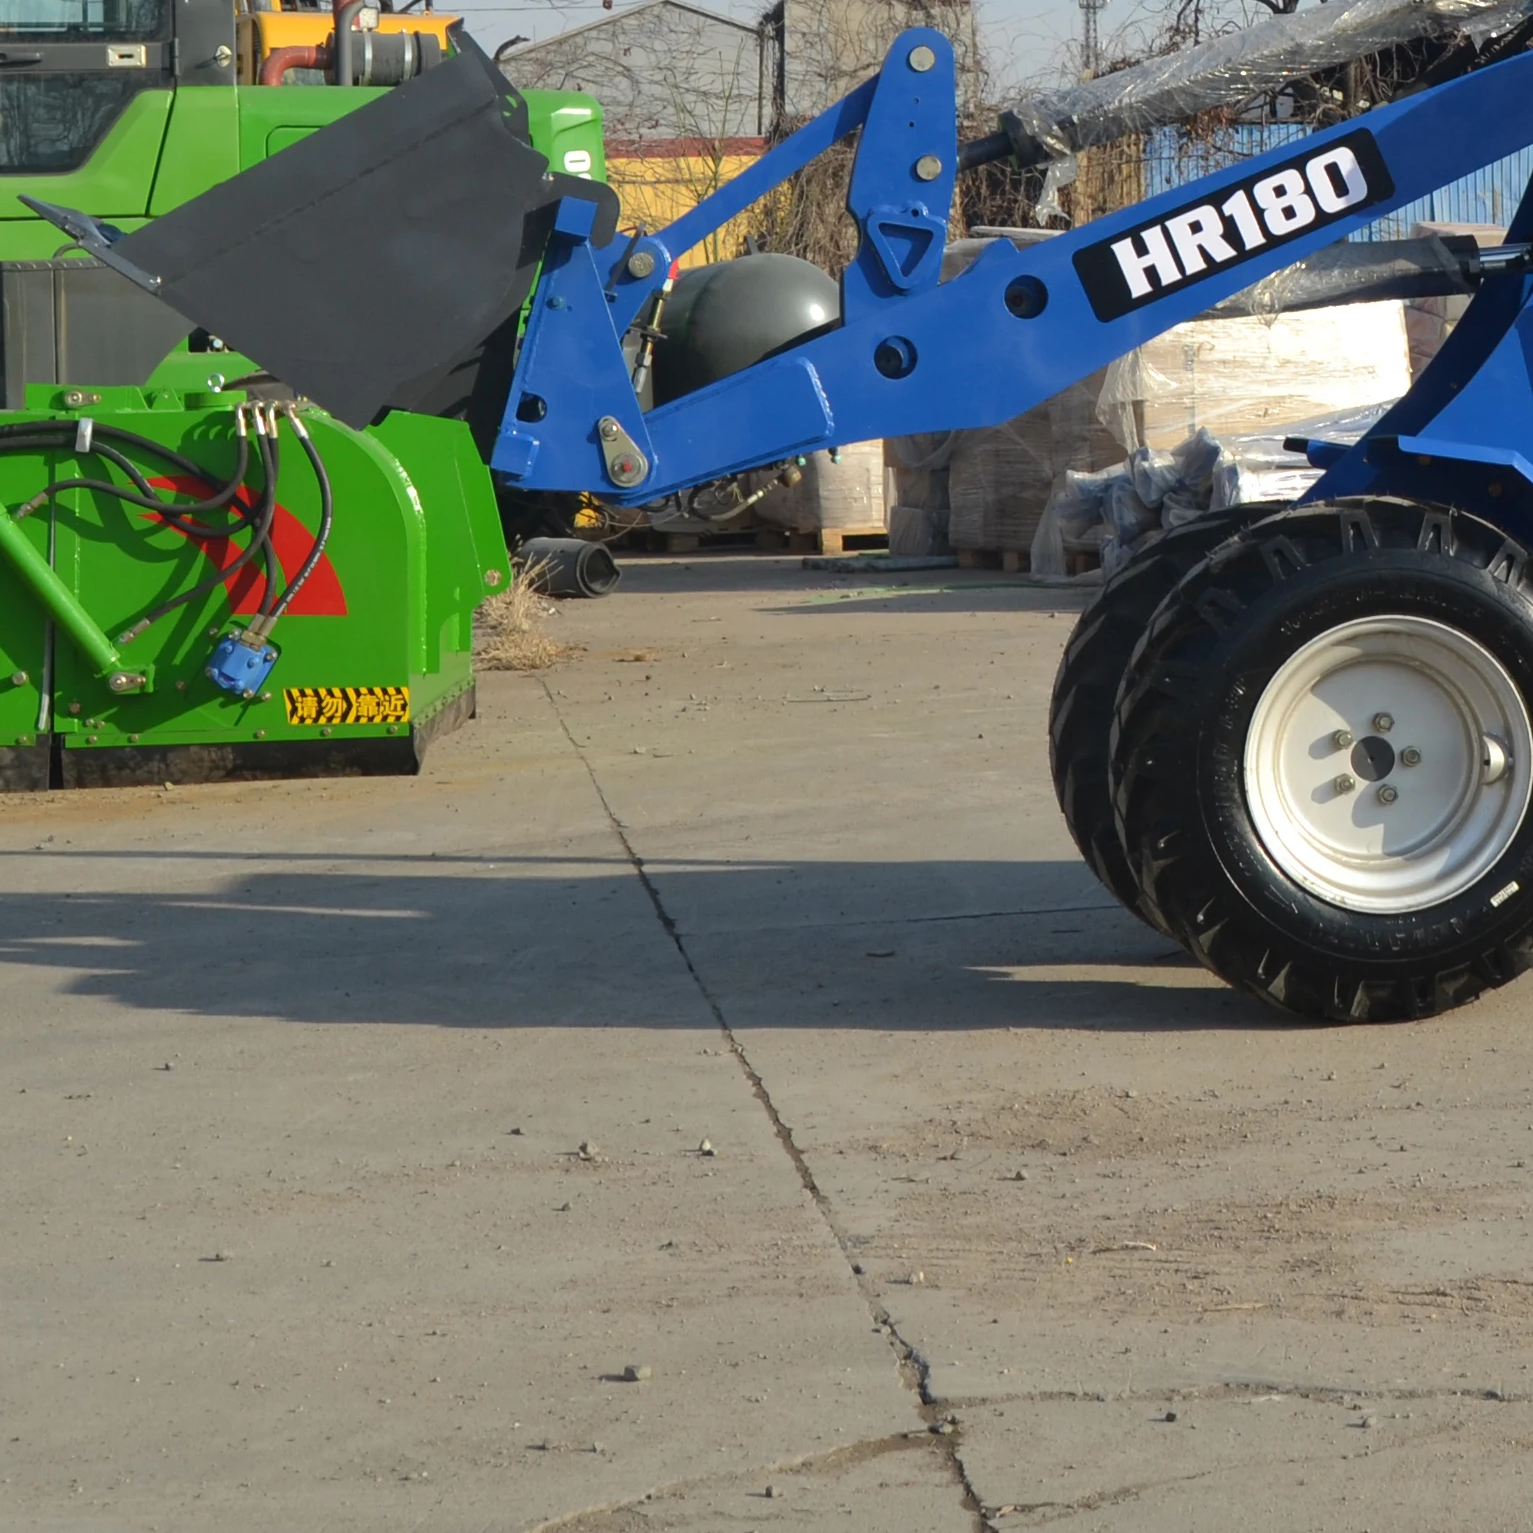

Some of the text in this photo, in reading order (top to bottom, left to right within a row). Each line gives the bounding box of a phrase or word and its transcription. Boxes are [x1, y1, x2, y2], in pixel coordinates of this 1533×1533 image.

[1110, 146, 1367, 299] HR180
[295, 694, 405, 719] 请勿靠近
